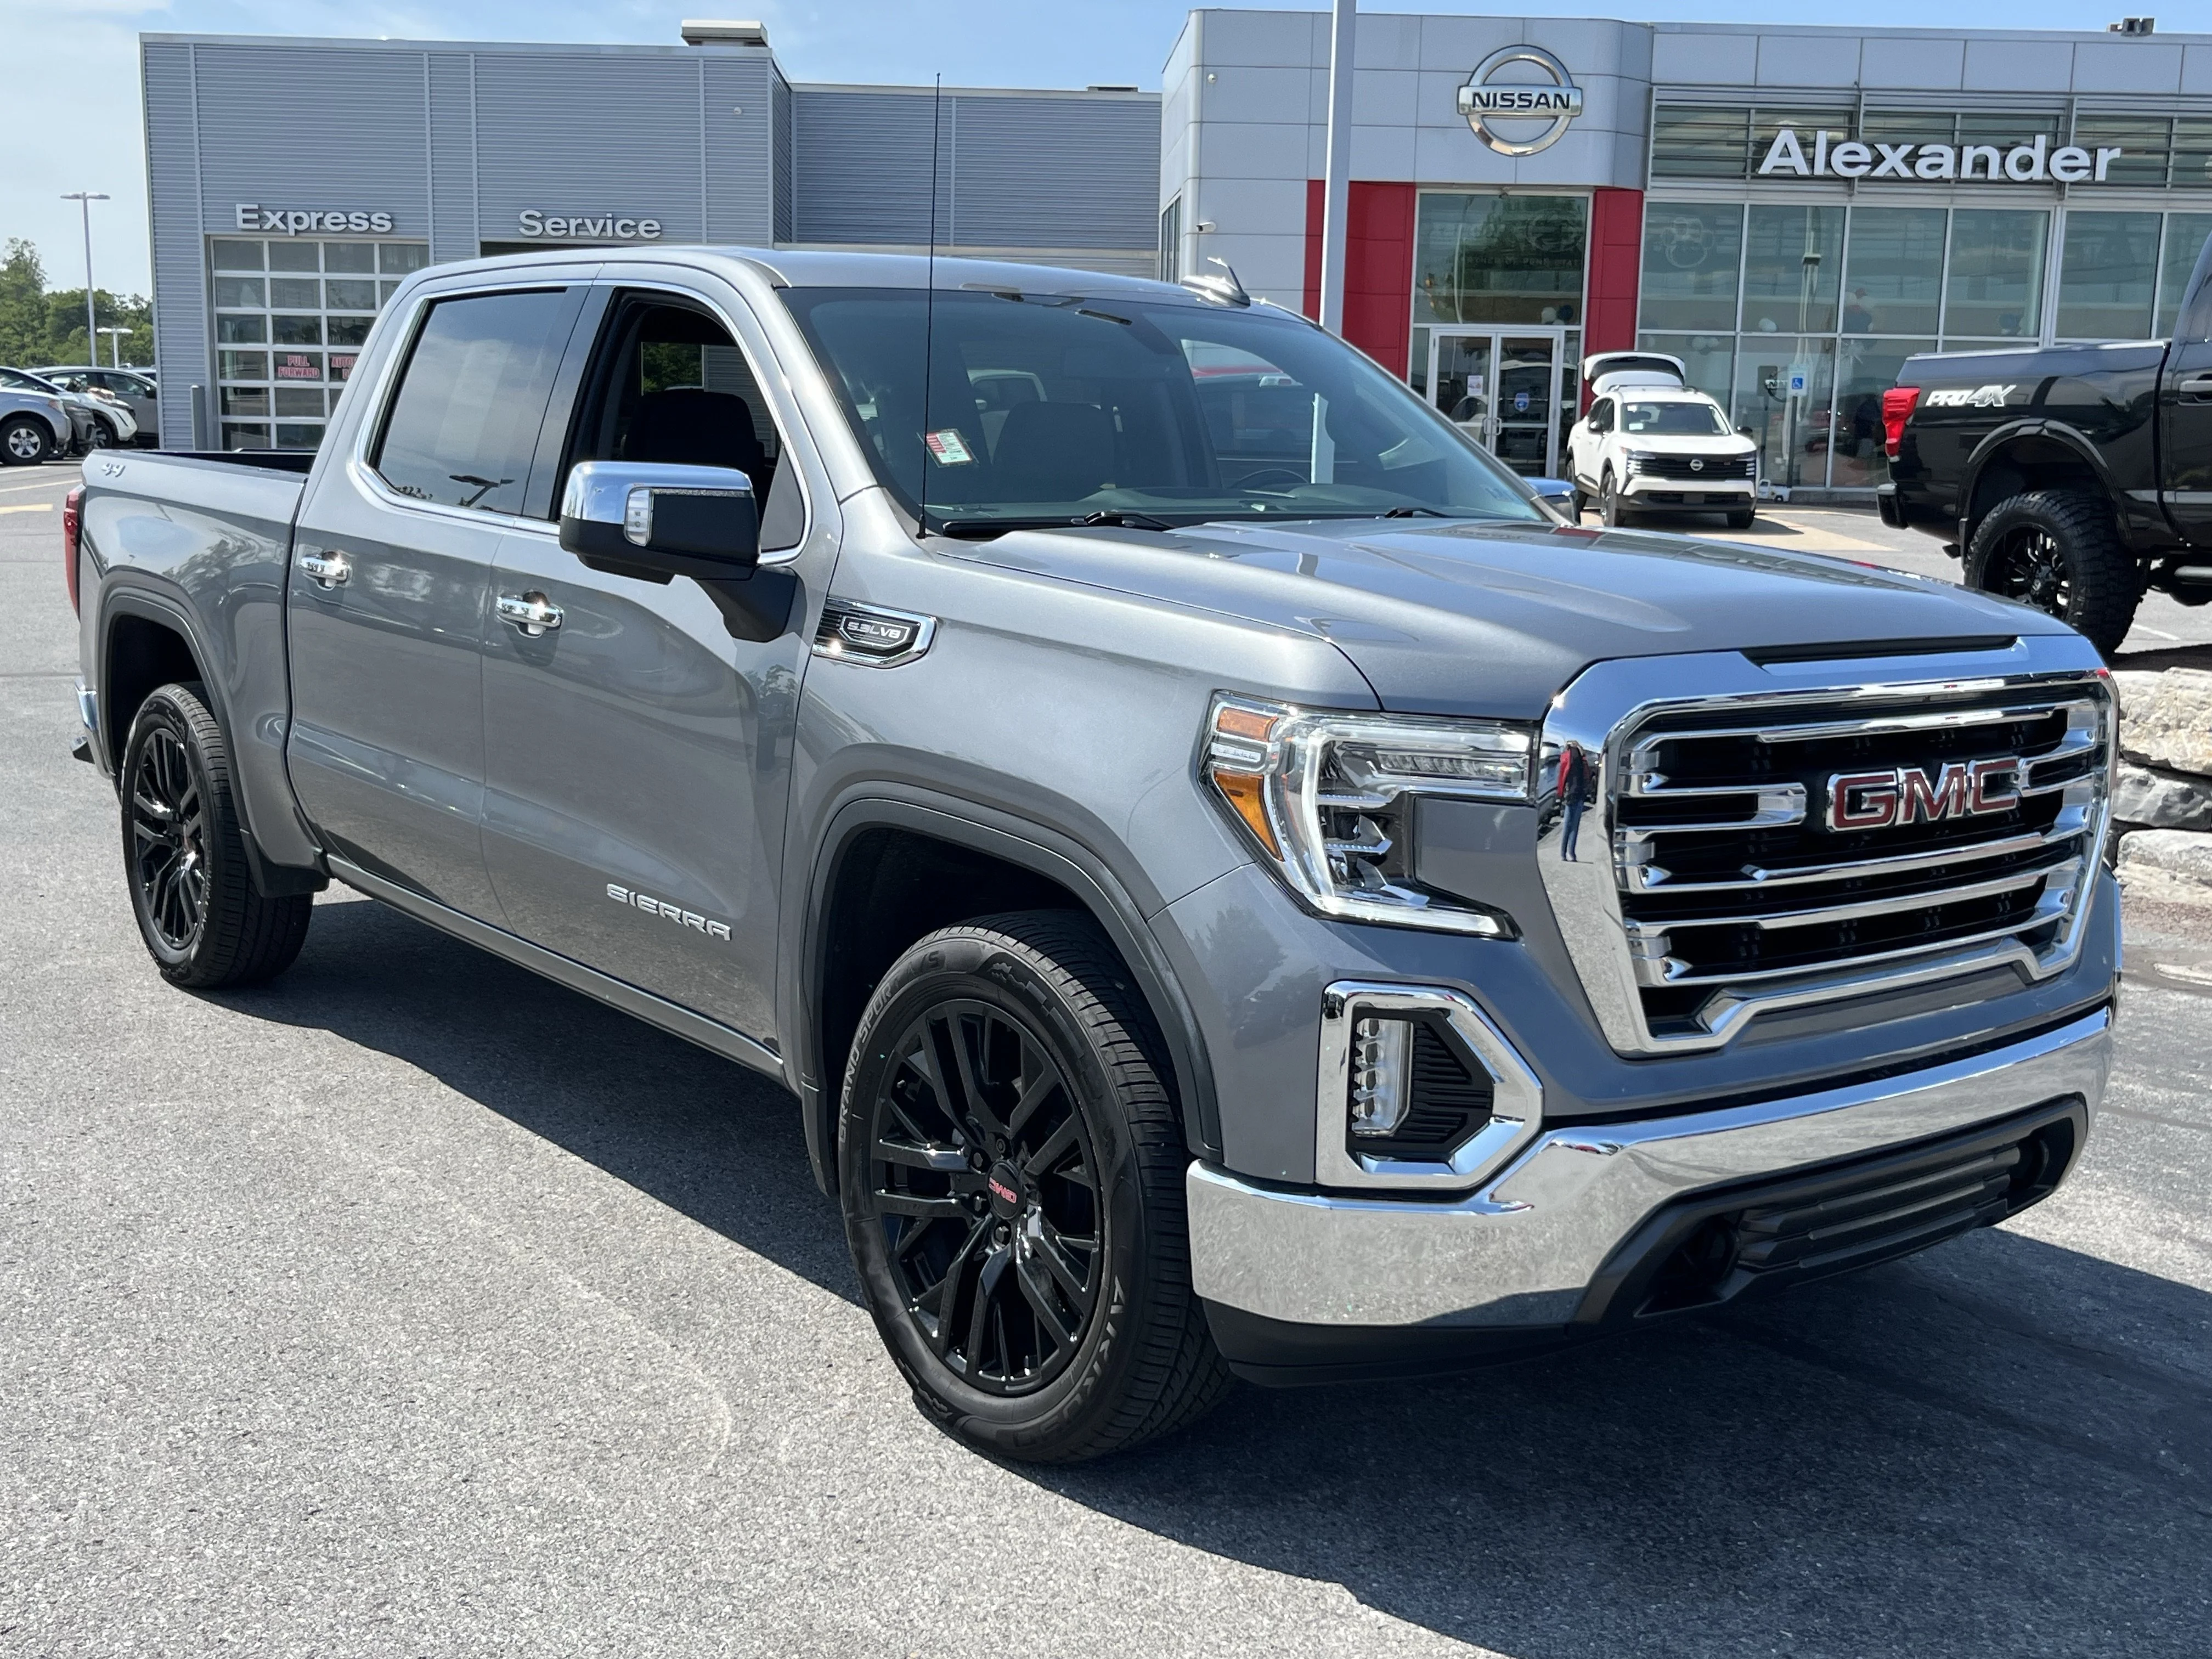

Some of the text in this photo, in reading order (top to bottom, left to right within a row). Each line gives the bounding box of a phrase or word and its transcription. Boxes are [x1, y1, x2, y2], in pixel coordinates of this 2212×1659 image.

[1472, 91, 1570, 109] NISSAN
[1758, 129, 2121, 182] Alexander
[236, 204, 392, 236] Express
[518, 210, 661, 239] Service
[278, 366, 320, 378] FORWARD
[287, 355, 310, 366] PULL
[1826, 756, 2021, 832] GMC
[607, 883, 731, 941] SIERRA
[839, 1045, 860, 1143] GRAND
